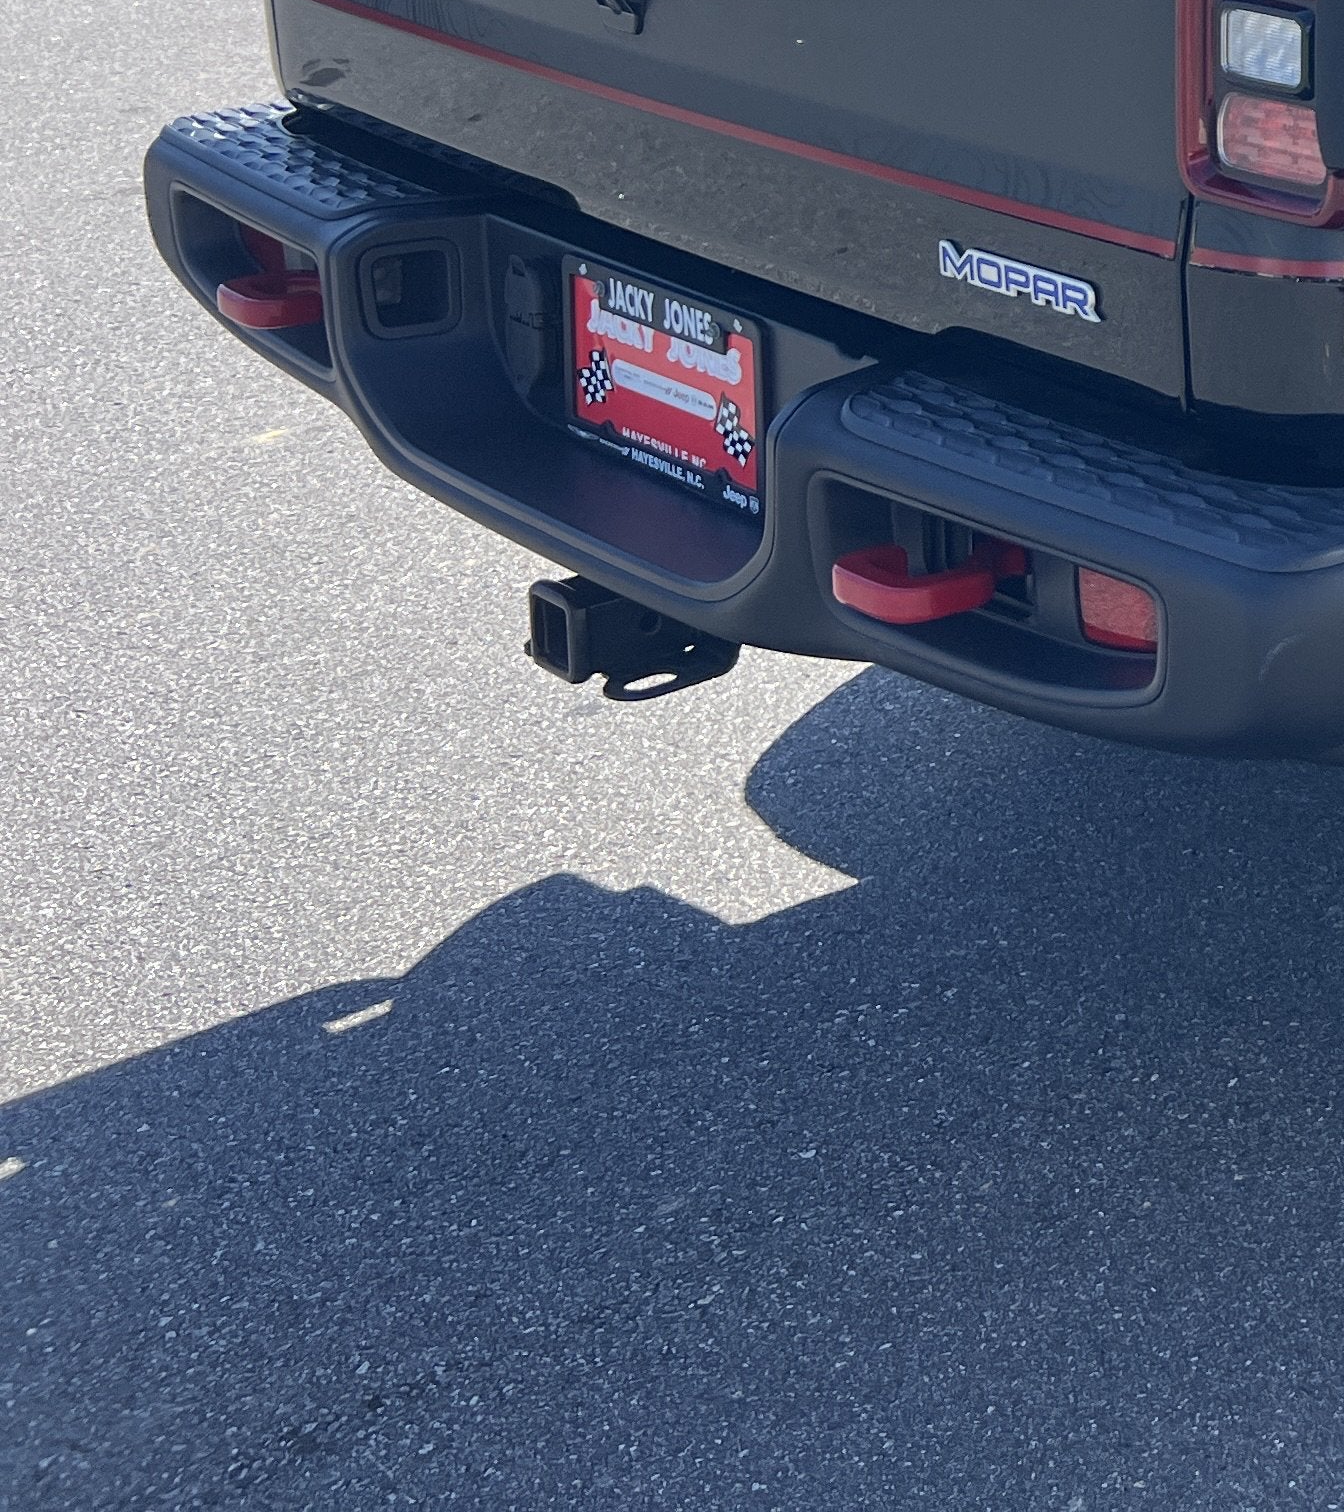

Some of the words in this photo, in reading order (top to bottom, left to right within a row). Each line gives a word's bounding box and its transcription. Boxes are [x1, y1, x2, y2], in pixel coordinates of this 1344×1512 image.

[608, 277, 655, 323] JACKY
[663, 298, 714, 346] JONES
[938, 239, 1102, 324] MOPAR
[722, 485, 748, 509] Jeep
